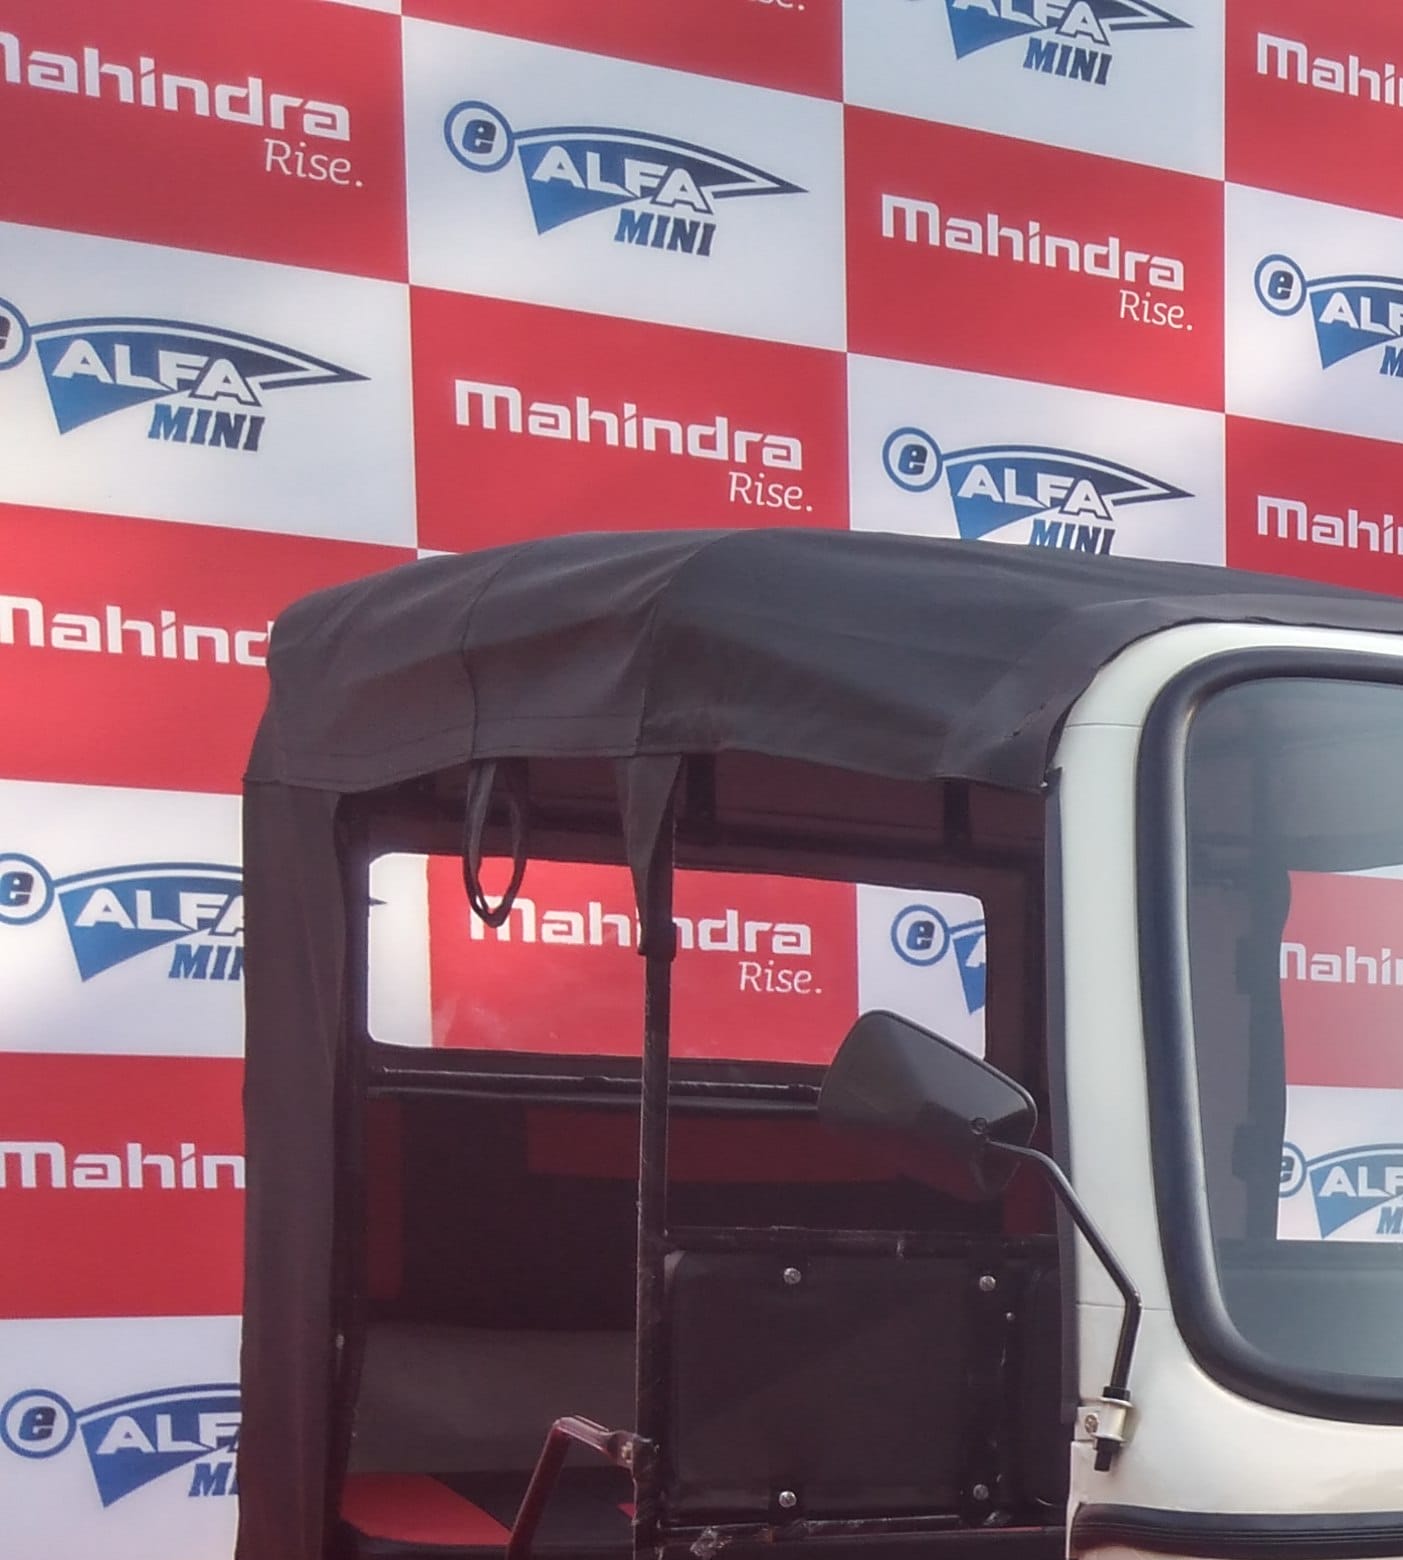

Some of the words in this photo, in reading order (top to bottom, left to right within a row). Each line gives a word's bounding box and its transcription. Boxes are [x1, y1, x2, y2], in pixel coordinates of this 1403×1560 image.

[1023, 37, 1113, 85] MINI
[0, 31, 350, 142] ahindra
[264, 139, 364, 188] Rise.
[532, 144, 714, 215] ALFA
[614, 210, 717, 256] MINI
[881, 193, 1185, 292] Mahindra
[1120, 288, 1193, 332] Rise.
[53, 340, 262, 406] ALFA
[148, 404, 265, 452] MINI
[456, 380, 802, 471] Mahindra
[729, 473, 813, 512] Rise.
[958, 465, 1113, 522] ALFA
[1028, 518, 1115, 557] MINI
[470, 895, 812, 956] Mahndra
[739, 960, 822, 995] Rise.
